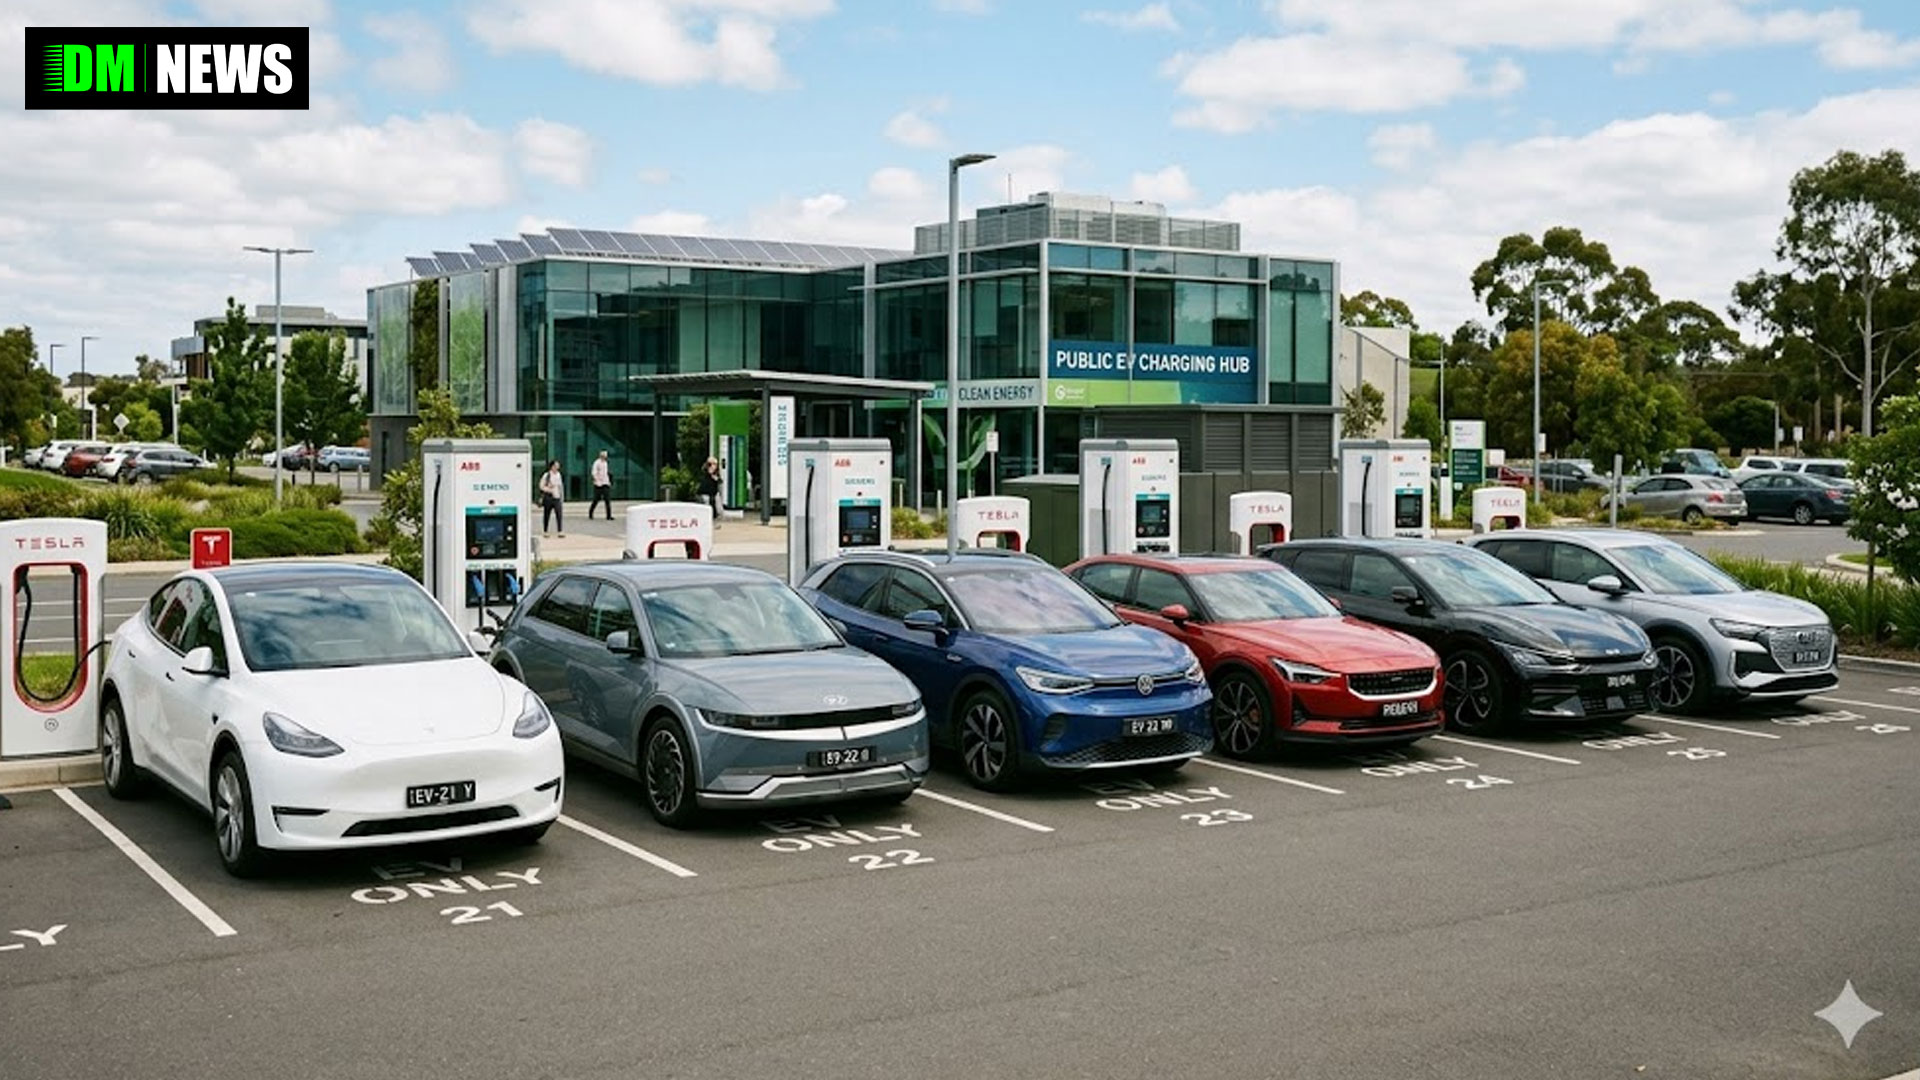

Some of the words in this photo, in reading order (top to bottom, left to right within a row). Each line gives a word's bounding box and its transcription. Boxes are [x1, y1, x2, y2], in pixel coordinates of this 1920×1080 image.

[1056, 350, 1113, 369] PUBLIC
[1139, 353, 1216, 372] CHARGING
[1219, 356, 1250, 373] HUB
[958, 387, 991, 401] CLEAN
[993, 385, 1034, 401] ENERGY
[460, 461, 481, 471] ABB
[647, 517, 699, 529] TESLA
[15, 536, 85, 549] TESLA
[464, 783, 473, 799] Y
[1446, 775, 1515, 790] 24
[1096, 786, 1233, 811] ONLY
[1180, 809, 1253, 827] 23
[762, 823, 922, 852] ONLY
[848, 849, 935, 871] 22
[351, 867, 542, 904] ONLY
[440, 901, 524, 925] 21
